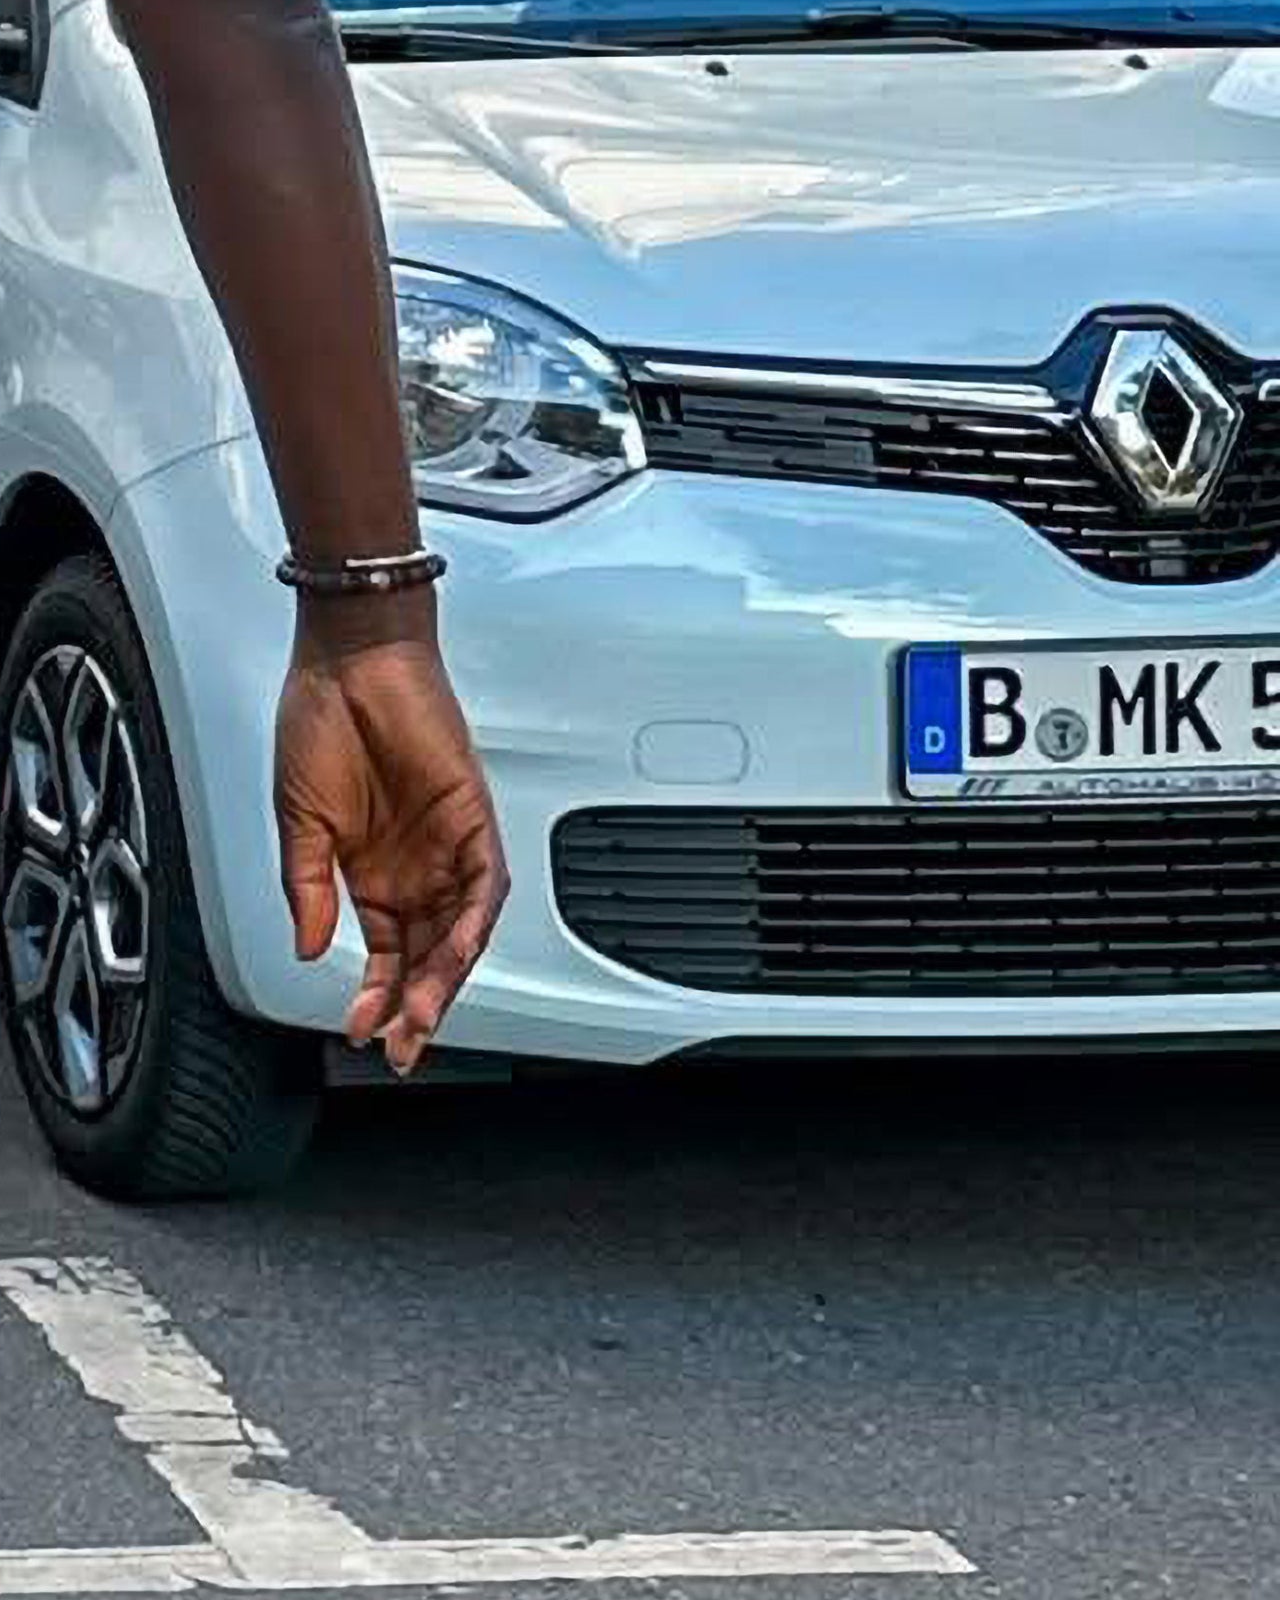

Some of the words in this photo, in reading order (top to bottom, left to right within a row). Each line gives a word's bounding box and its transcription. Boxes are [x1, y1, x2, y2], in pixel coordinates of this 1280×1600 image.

[923, 725, 946, 754] D
[968, 666, 1026, 757] B
[1098, 660, 1223, 756] MK
